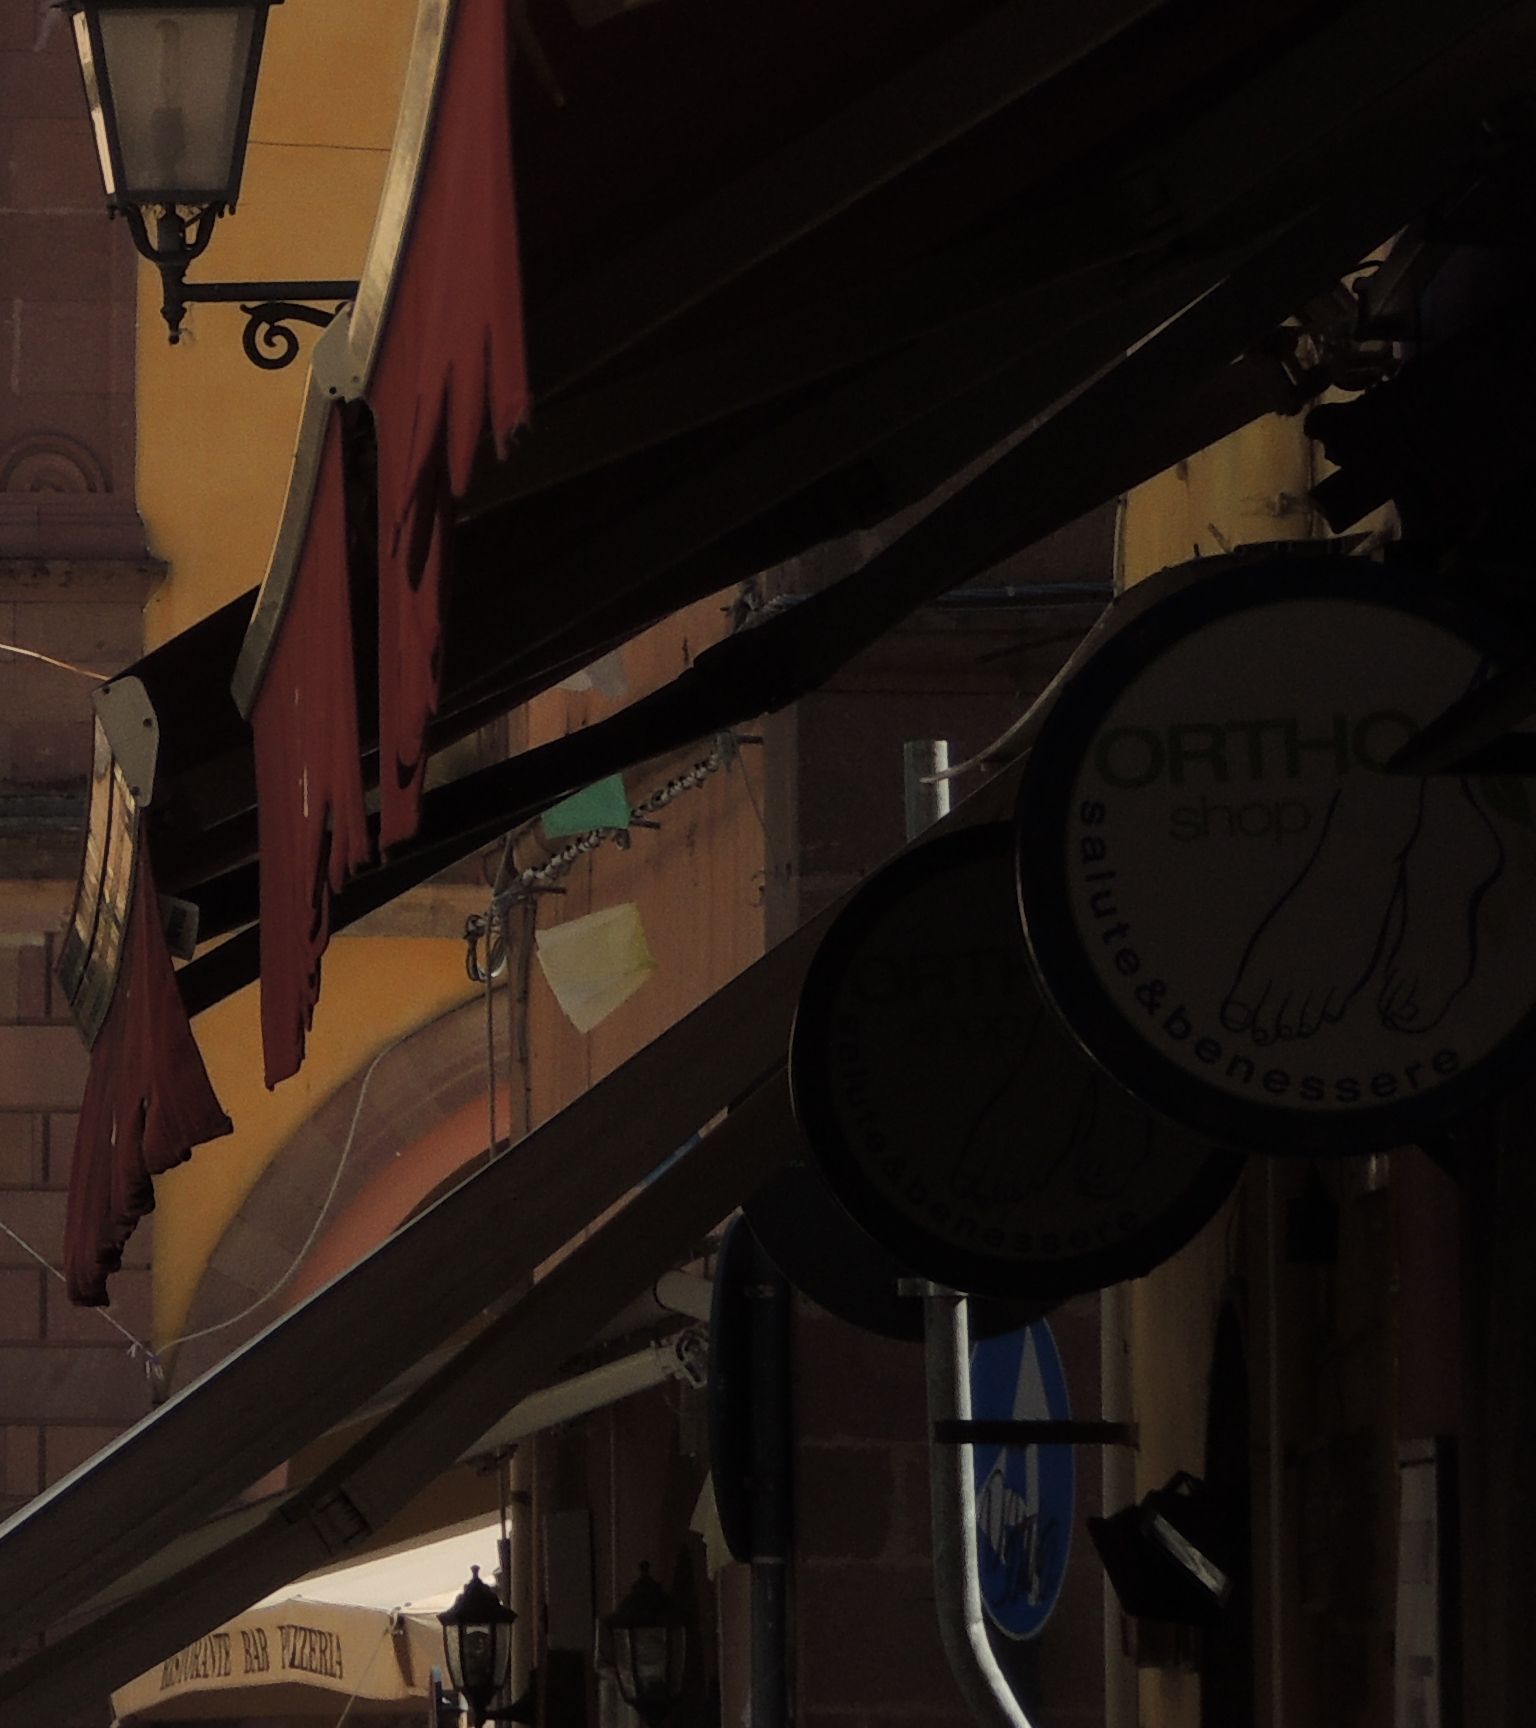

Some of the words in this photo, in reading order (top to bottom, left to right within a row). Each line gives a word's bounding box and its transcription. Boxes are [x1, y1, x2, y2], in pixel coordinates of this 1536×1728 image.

[1094, 710, 1424, 788] ORTHO
[1168, 795, 1312, 850] shop
[240, 1627, 271, 1674] BAR
[277, 1624, 344, 1680] PIZZERIA
